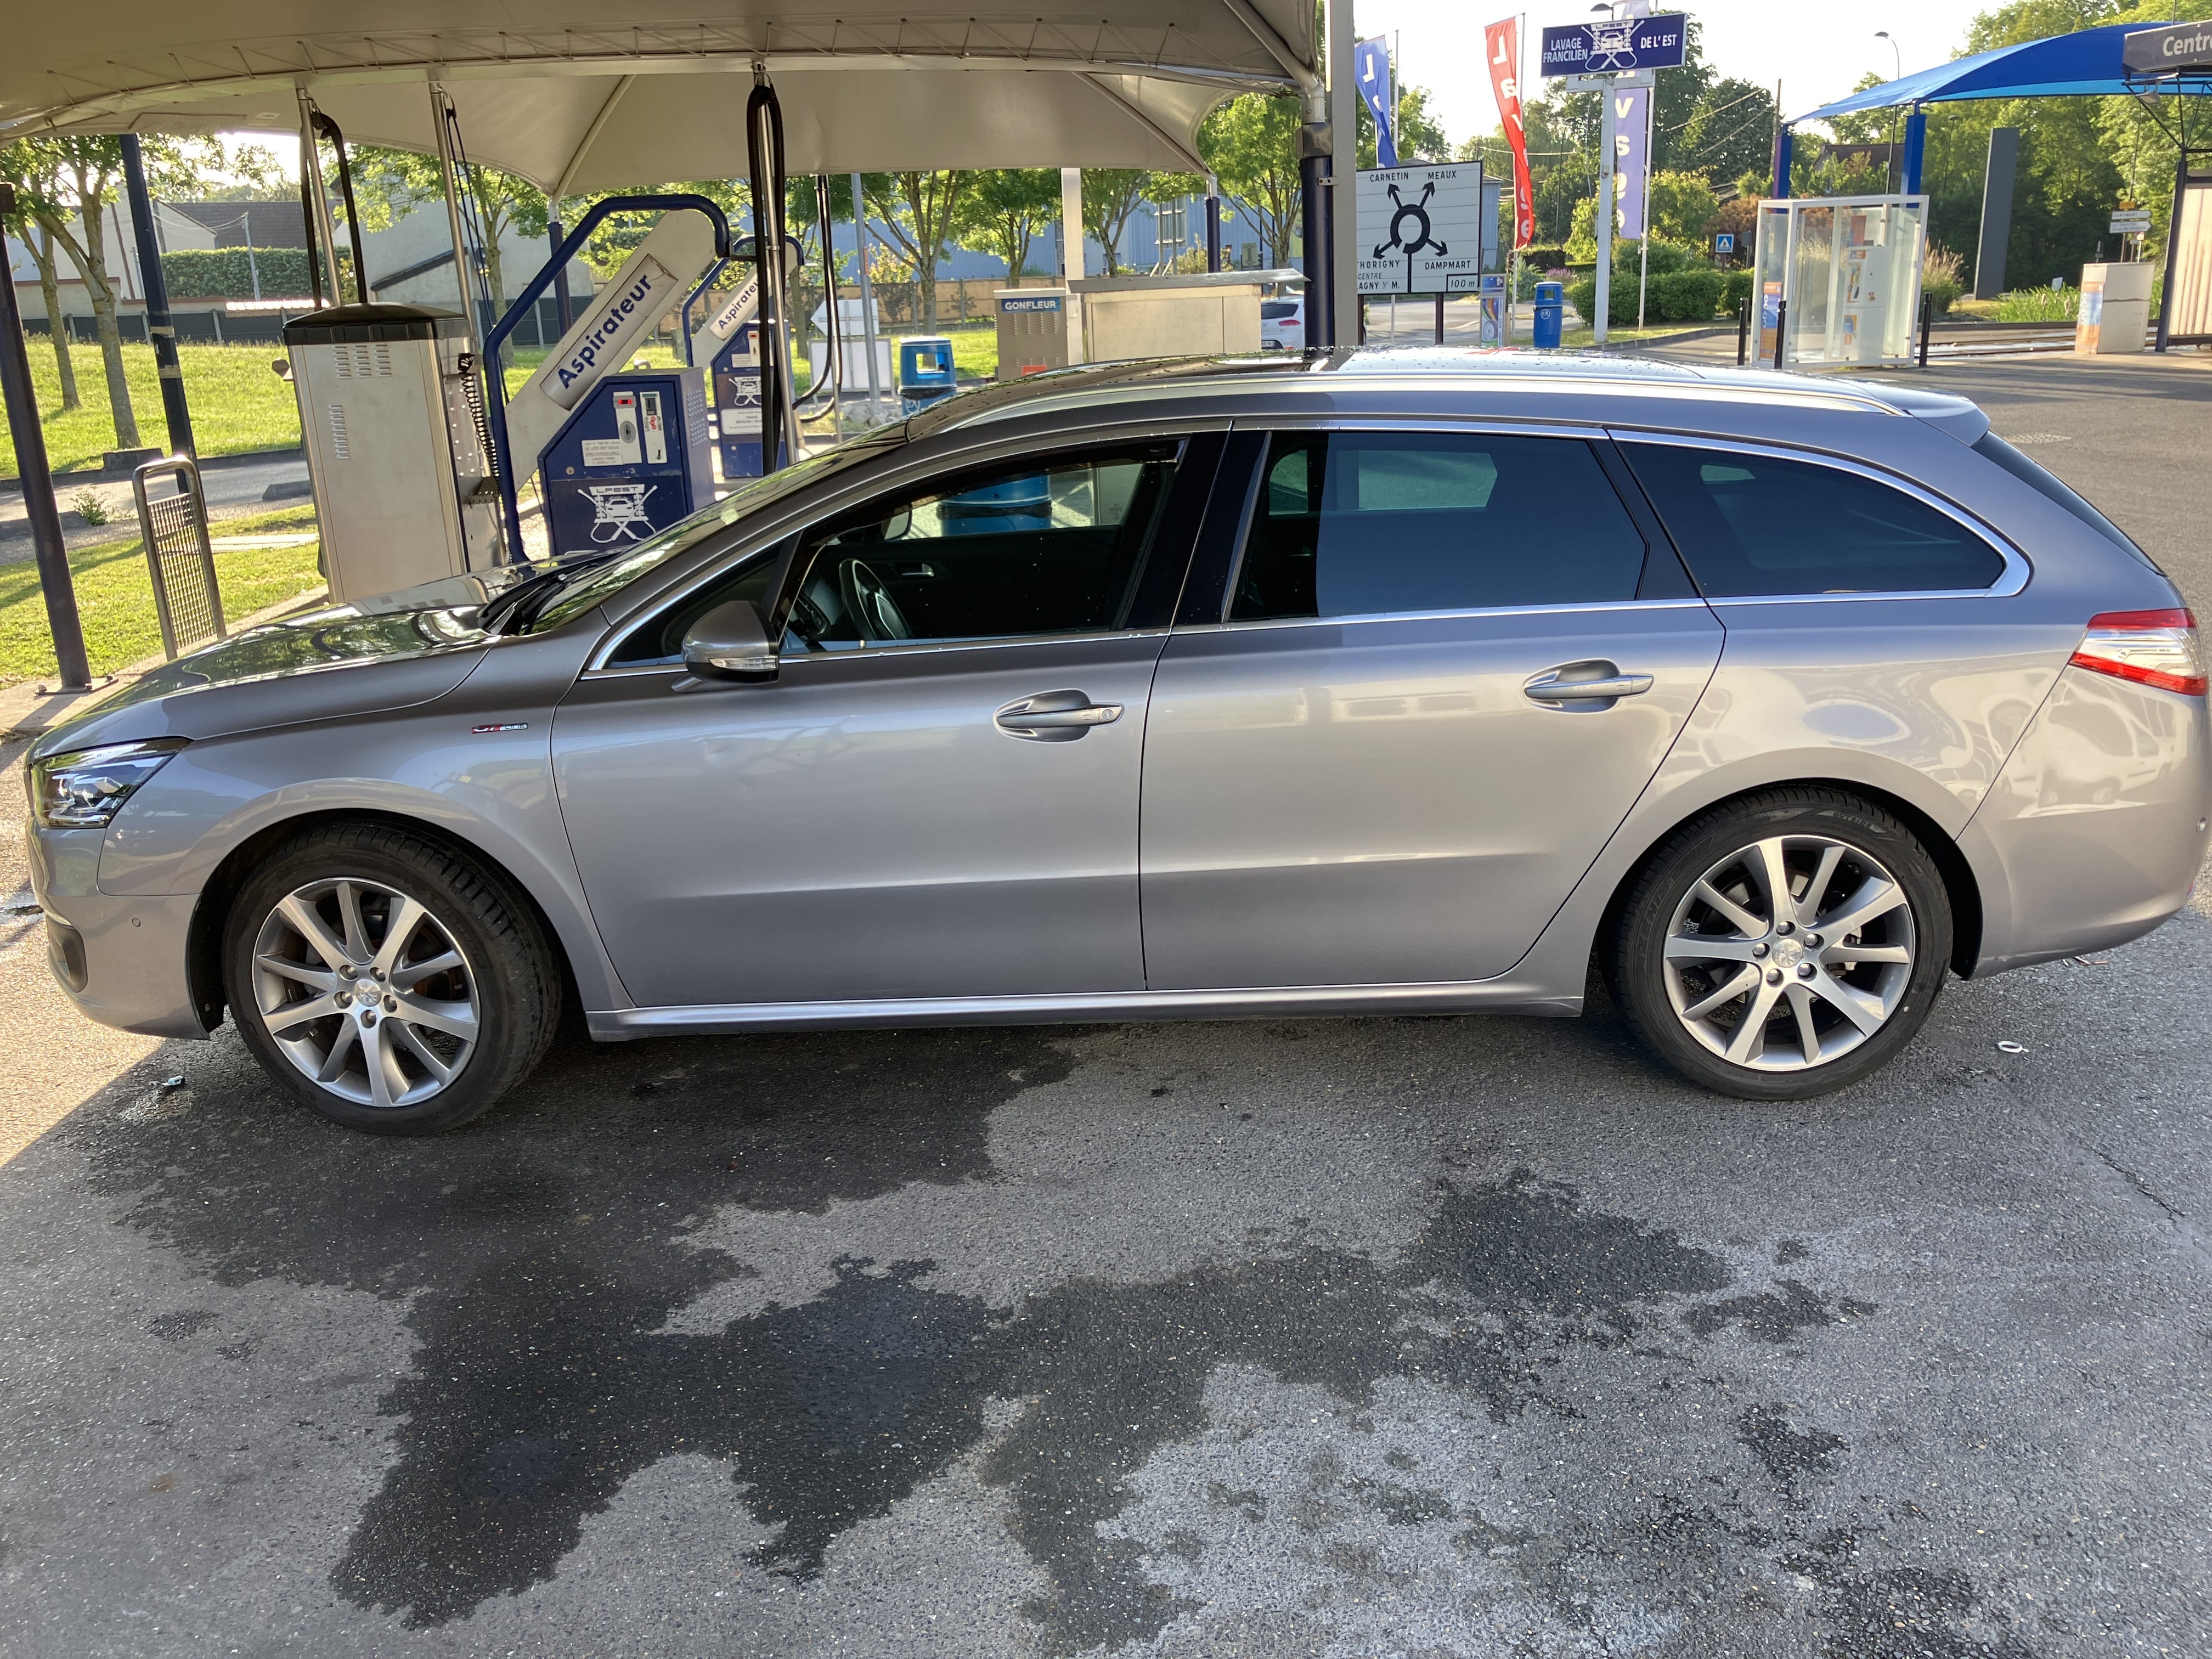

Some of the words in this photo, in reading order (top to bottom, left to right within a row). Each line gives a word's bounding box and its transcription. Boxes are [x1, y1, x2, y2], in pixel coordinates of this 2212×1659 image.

[1550, 37, 1582, 51] LAVAGE
[1640, 36, 1652, 49] DE
[1662, 34, 1677, 47] EST
[2163, 32, 2212, 57] Centr
[1543, 48, 1588, 64] FRANCILIEN
[1370, 171, 1409, 183] CARNETIN
[1427, 170, 1457, 180] MEAUX
[1425, 261, 1471, 270] DAMPMART
[1357, 281, 1379, 290] AGNY
[1451, 279, 1466, 288] 100
[718, 279, 759, 330] Aspirateu
[1005, 300, 1057, 311] GONFLEUR
[557, 274, 652, 389] Aspirateur
